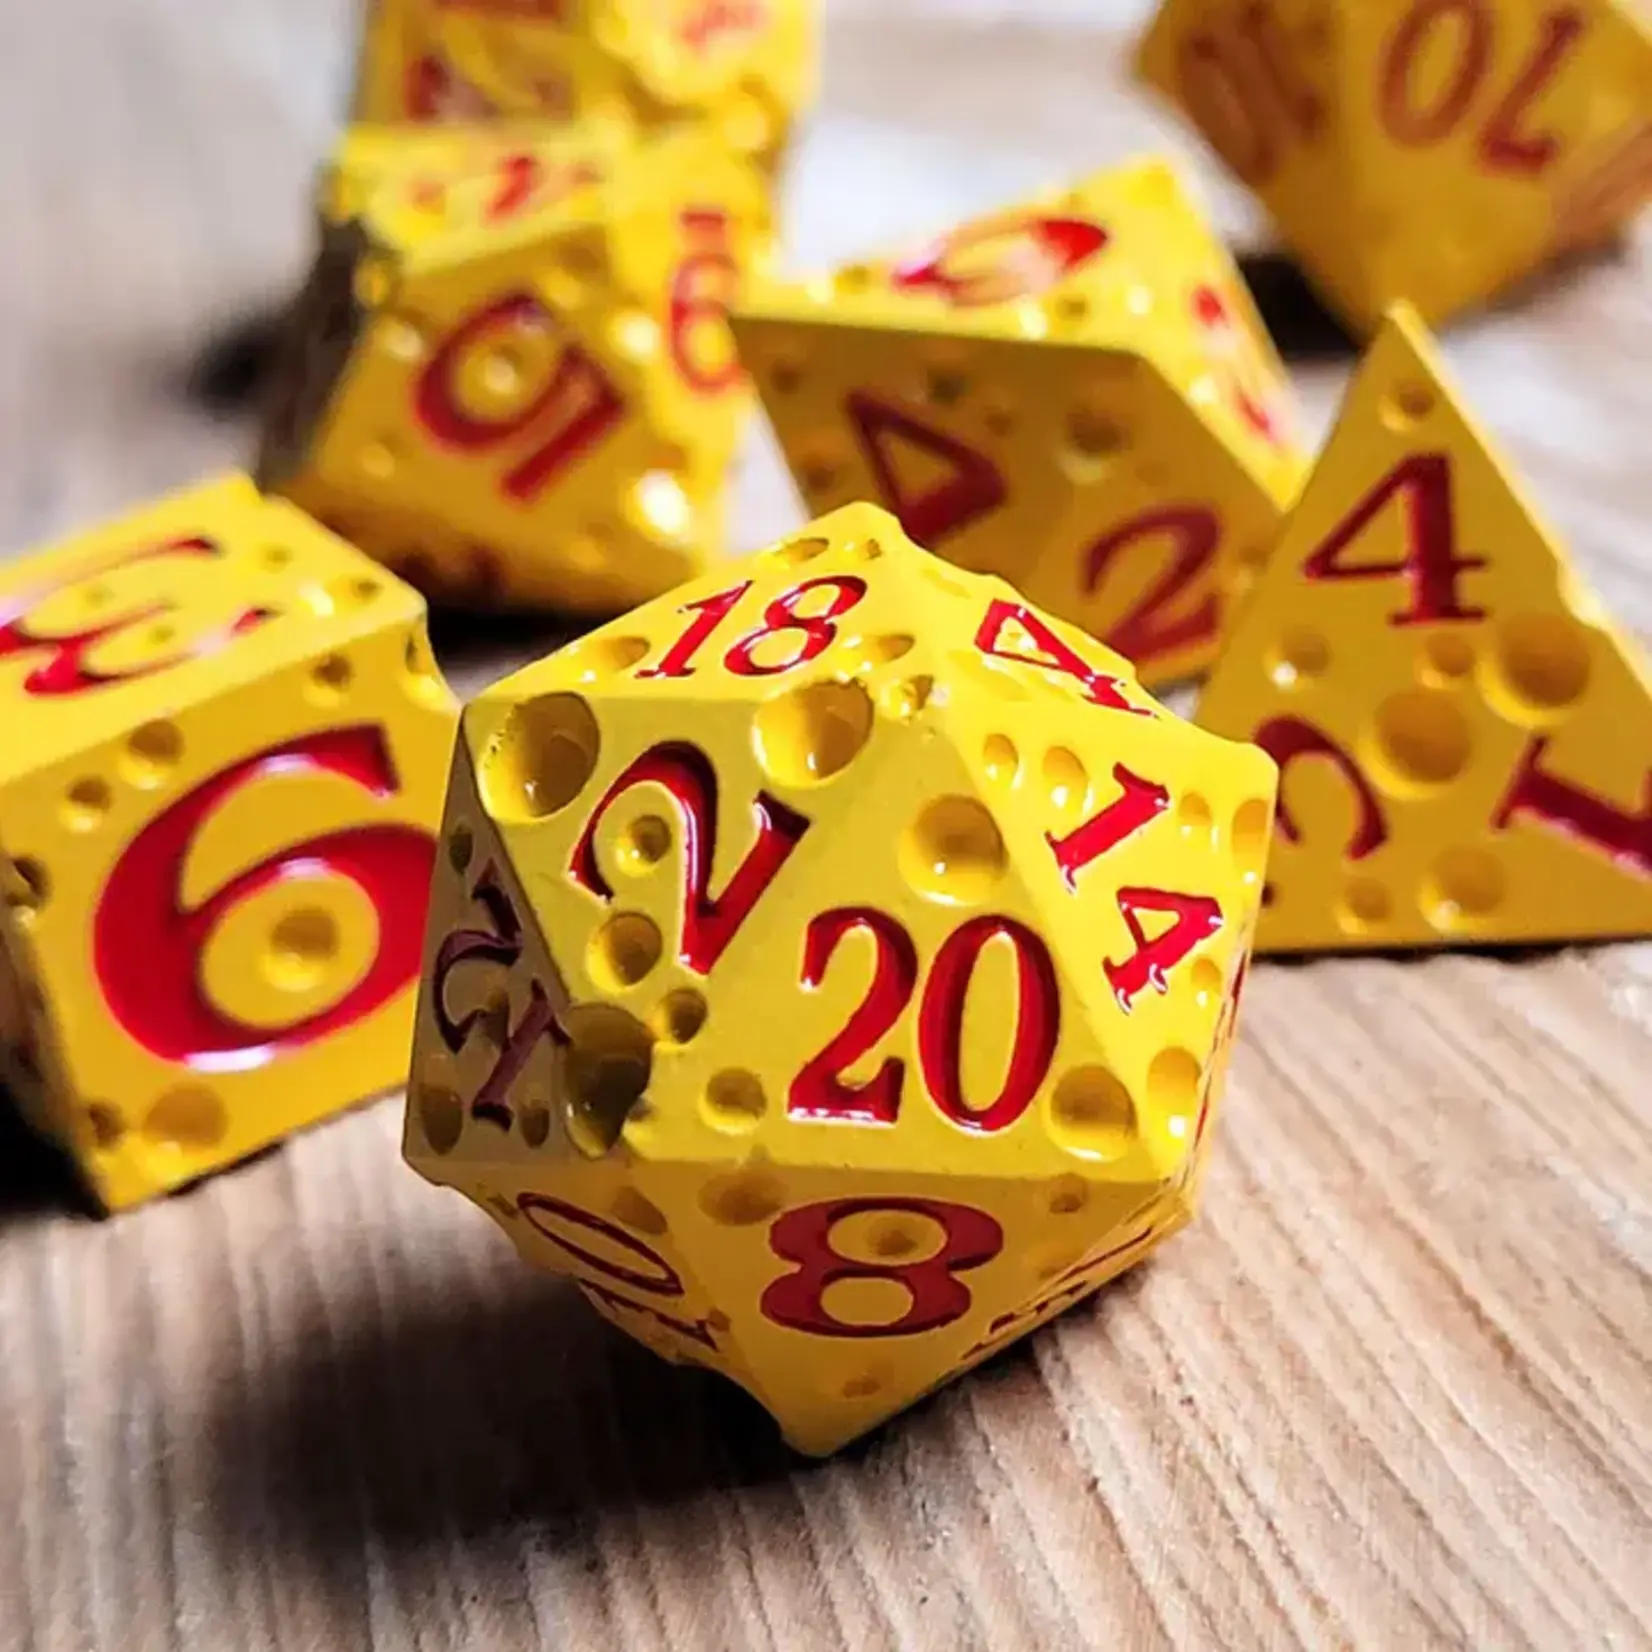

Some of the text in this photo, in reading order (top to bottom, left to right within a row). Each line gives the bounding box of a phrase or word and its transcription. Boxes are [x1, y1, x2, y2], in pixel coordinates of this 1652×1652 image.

[1081, 504, 1222, 668] 2
[1302, 452, 1487, 624] 4
[637, 575, 868, 680] 18
[975, 597, 1162, 720] 4
[92, 722, 438, 1070] 6
[569, 740, 811, 977] 2
[787, 905, 1061, 1134] 20
[760, 1196, 1004, 1338] 8
